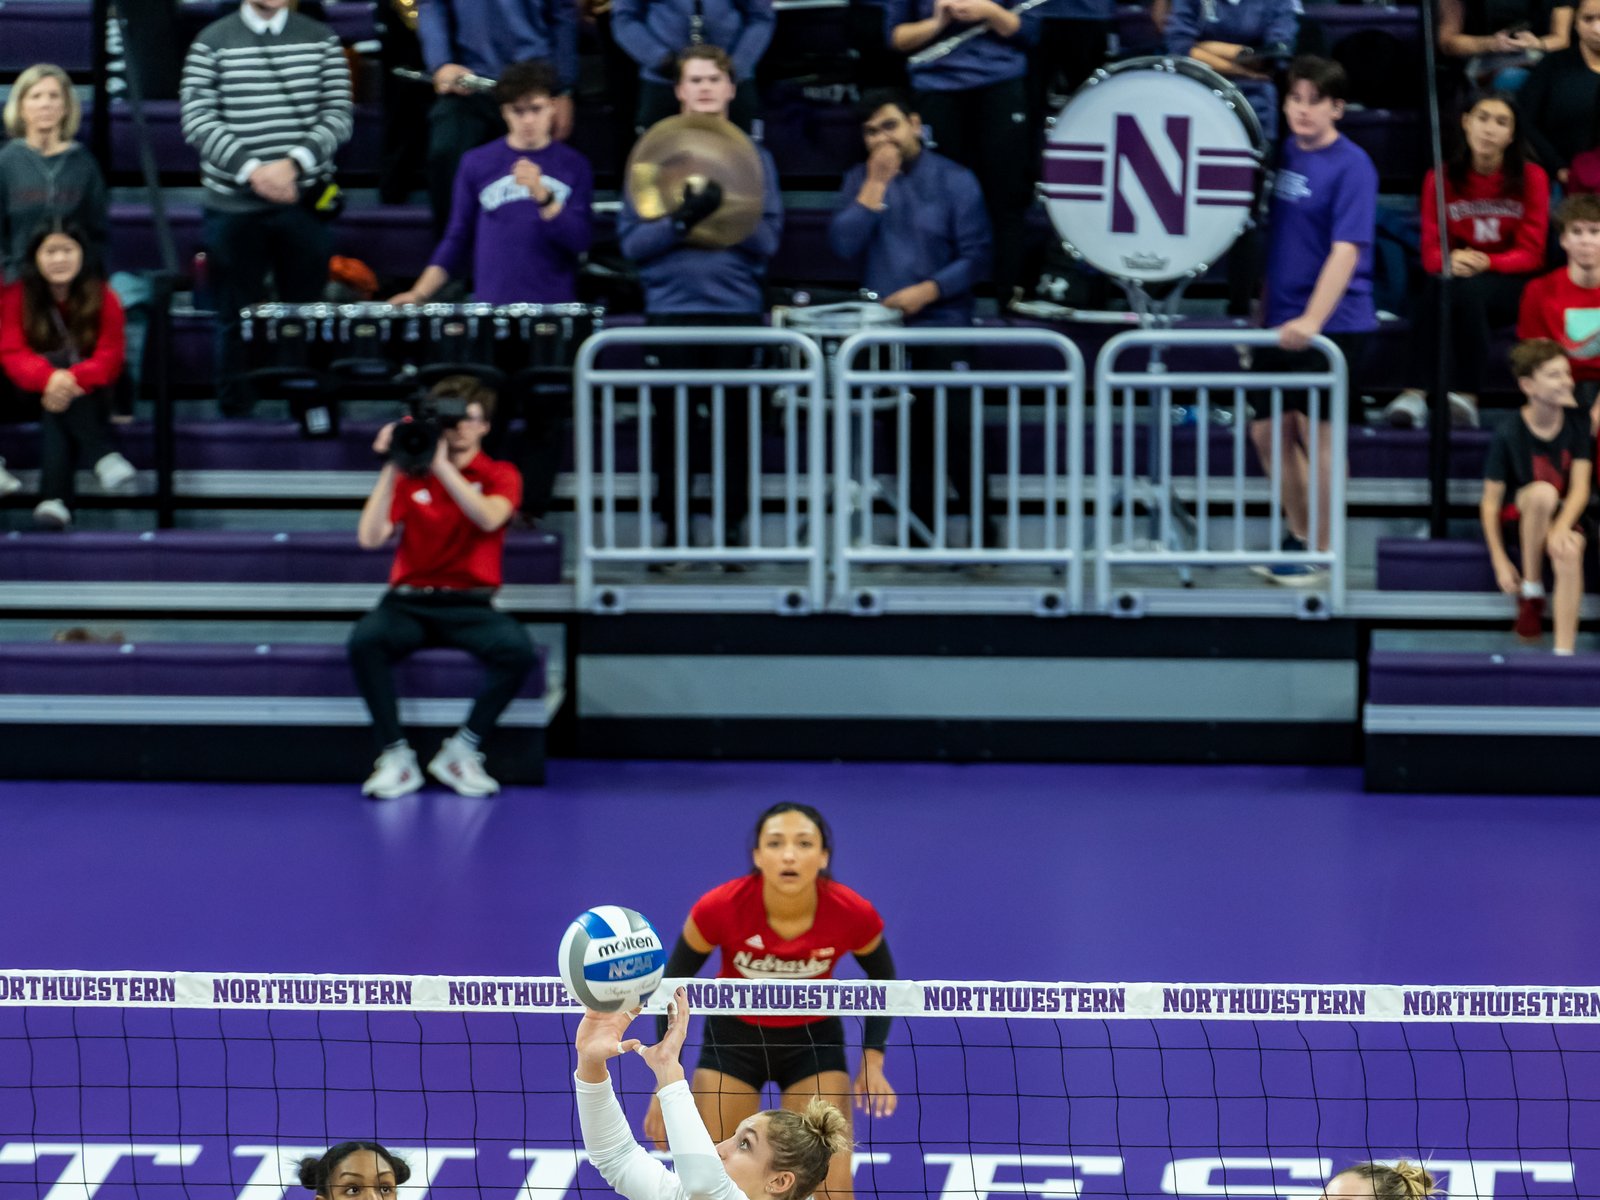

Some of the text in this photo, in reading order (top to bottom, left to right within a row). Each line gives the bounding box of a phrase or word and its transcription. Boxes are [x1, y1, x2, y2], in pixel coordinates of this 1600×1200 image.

[1111, 113, 1191, 236] N
[1474, 217, 1501, 243] N
[598, 936, 654, 958] molten
[608, 954, 654, 980] NCAA
[213, 978, 413, 1005] NORTHWESTERN
[448, 981, 648, 1008] NORTHWE
[687, 984, 887, 1010] NORTHWESTERN
[923, 986, 1126, 1013] NORTHWESTERN
[1162, 988, 1366, 1015] NORTHWESTERN
